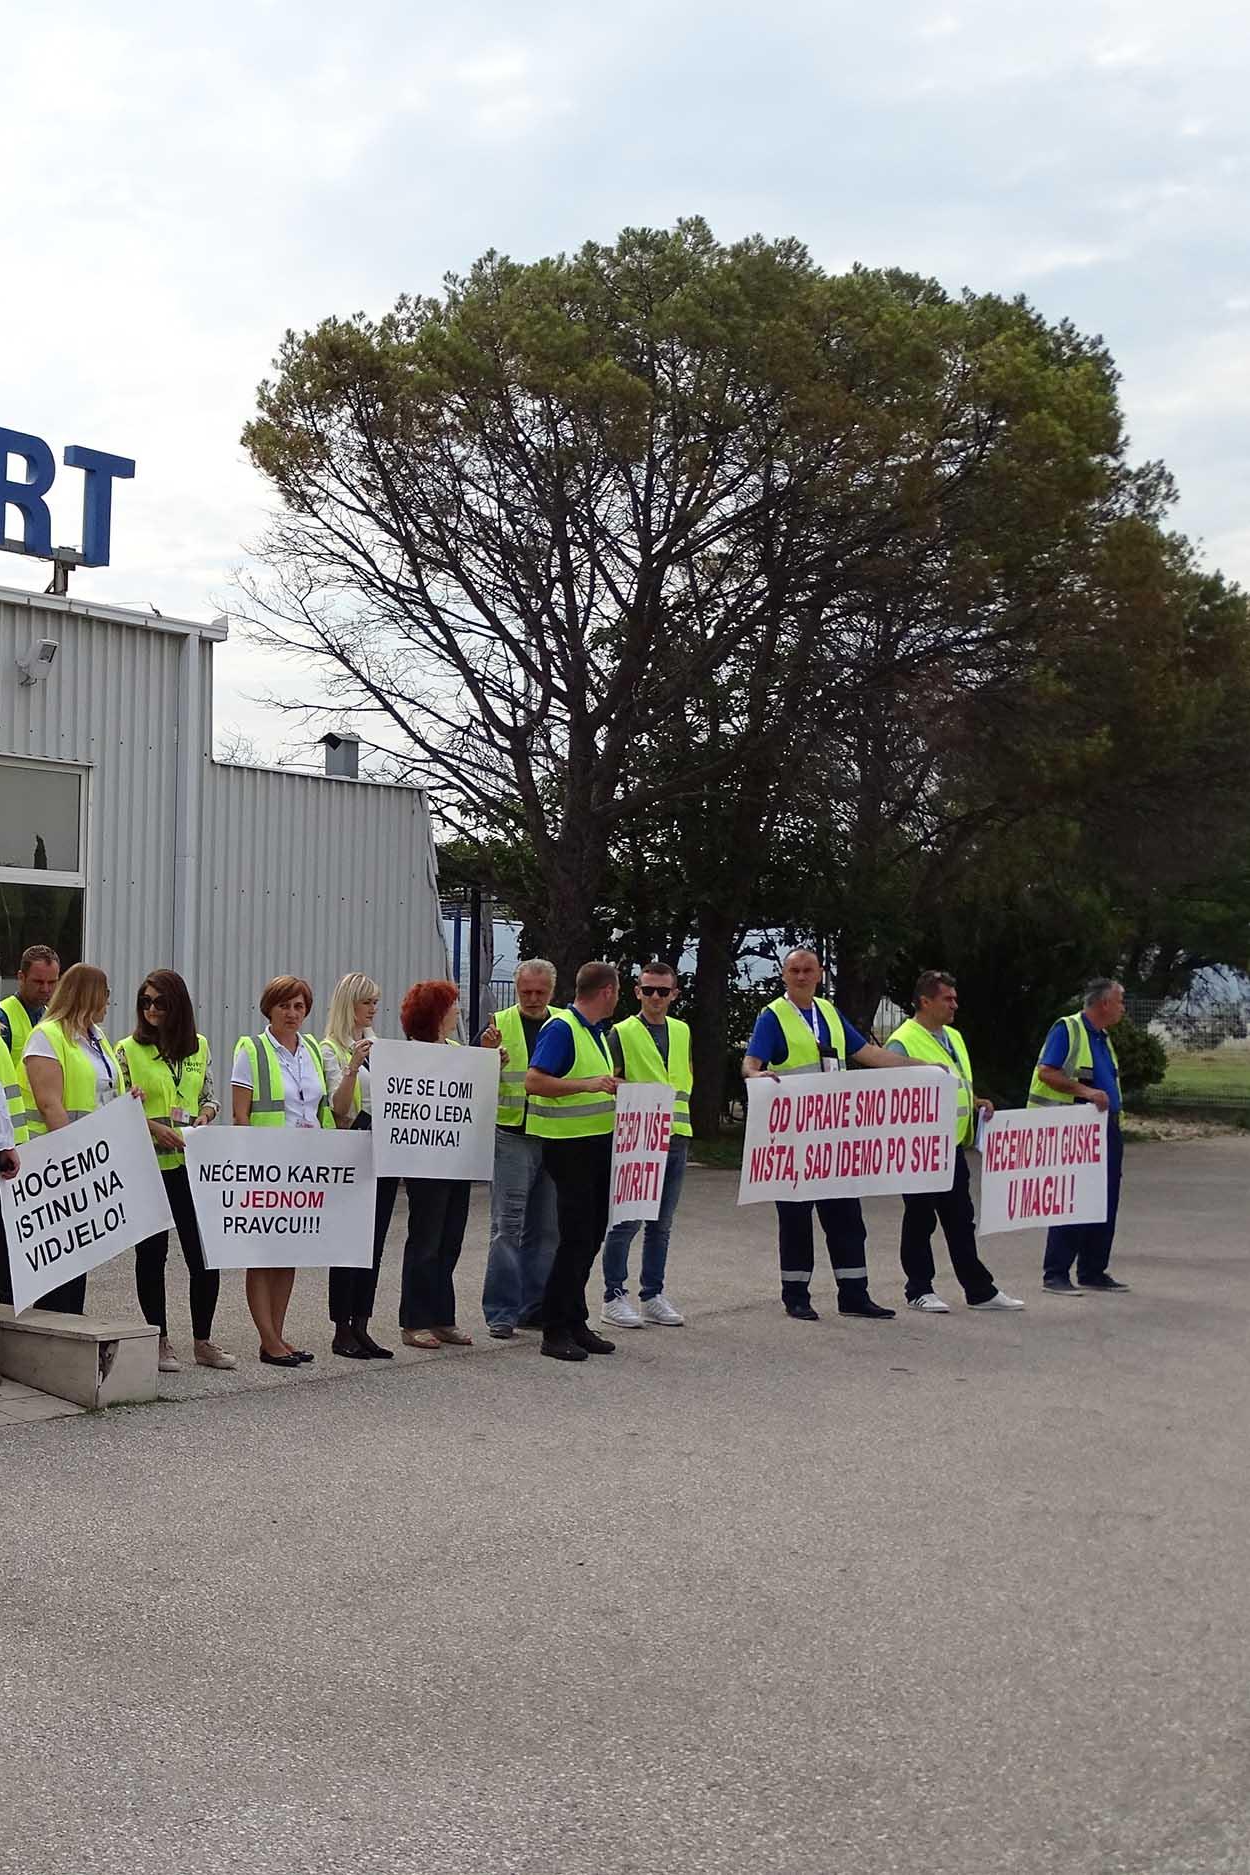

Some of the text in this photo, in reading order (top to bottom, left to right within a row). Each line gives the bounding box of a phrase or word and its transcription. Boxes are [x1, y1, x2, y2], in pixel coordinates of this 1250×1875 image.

[387, 1076, 472, 1099] SVE SE LOMI
[768, 1086, 940, 1133] OD UPRAVE SMO DOBILI
[383, 1102, 472, 1123] PREKO LEĐA
[390, 1127, 460, 1147] RADNIKA!
[986, 1119, 1101, 1173] NEĆEMO BITI GUSKE
[11, 1140, 110, 1207] HOĆEMO
[199, 1160, 356, 1184] NEĆEMO KARTE
[749, 1136, 799, 1190] NIŠTA,
[804, 1142, 832, 1181] SAD
[836, 1138, 882, 1177] IDEMO
[886, 1137, 907, 1174] PO
[911, 1135, 941, 1174] SVE
[15, 1170, 124, 1243] ISTINU NA
[222, 1190, 324, 1208] U JEDNOM
[1008, 1180, 1018, 1221] U
[1020, 1174, 1066, 1219] MAGLI
[25, 1202, 127, 1273] VIDJELO!
[223, 1216, 320, 1234] PRAVCU!!!
